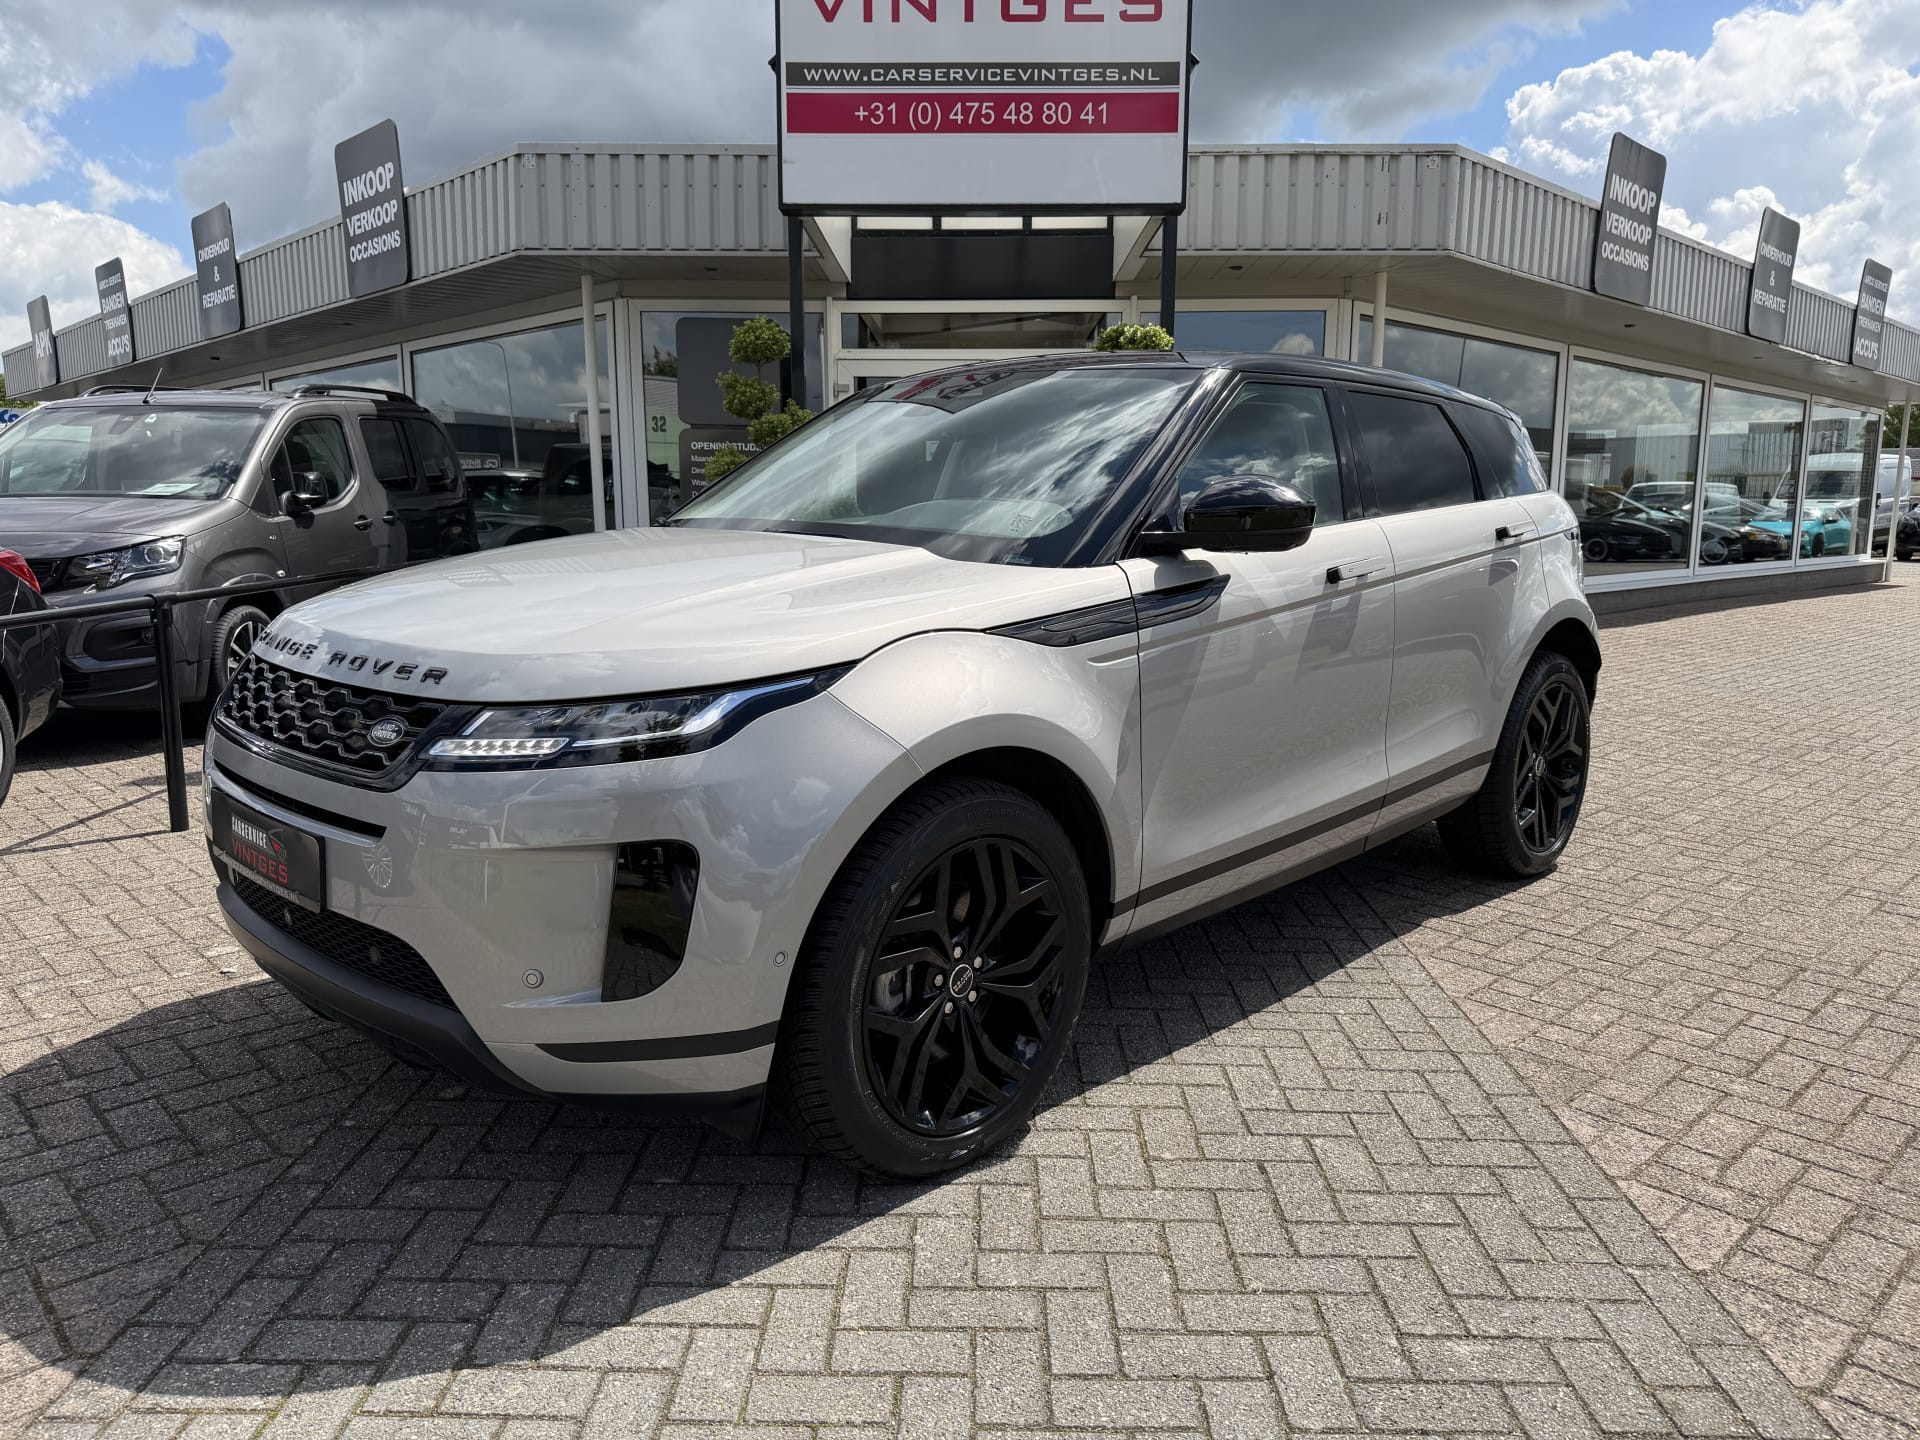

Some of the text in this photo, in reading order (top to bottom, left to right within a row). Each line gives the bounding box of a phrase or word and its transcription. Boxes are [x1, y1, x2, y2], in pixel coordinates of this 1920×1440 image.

[803, 67, 1160, 82] WWW.CARSERVICEVINTGES.NL
[854, 102, 1108, 130] +31 (0) 475 48 80 41
[343, 162, 394, 207] INKOOP
[1609, 173, 1657, 215] INKOOP
[346, 199, 398, 237] VERKOOP
[1605, 210, 1652, 246] VERKOOP
[198, 238, 230, 263] ONDERHOUD
[350, 229, 401, 263] OCCASIONS
[1601, 241, 1650, 272] OCCASIONS
[1760, 241, 1793, 267] ONDERHOUD
[213, 265, 220, 282] &
[1769, 269, 1776, 286] &
[101, 290, 125, 314] BANDEN
[202, 284, 236, 310] REPARATIE
[1753, 288, 1786, 314] REPARATIE
[1861, 292, 1885, 316] BANDEN
[35, 328, 53, 359] APK
[108, 334, 130, 358] ACCU'S
[1854, 337, 1879, 360] ACCU'S
[651, 415, 667, 432] 32
[259, 630, 448, 685] RANGE ROVER
[232, 838, 289, 885] VINTGES
